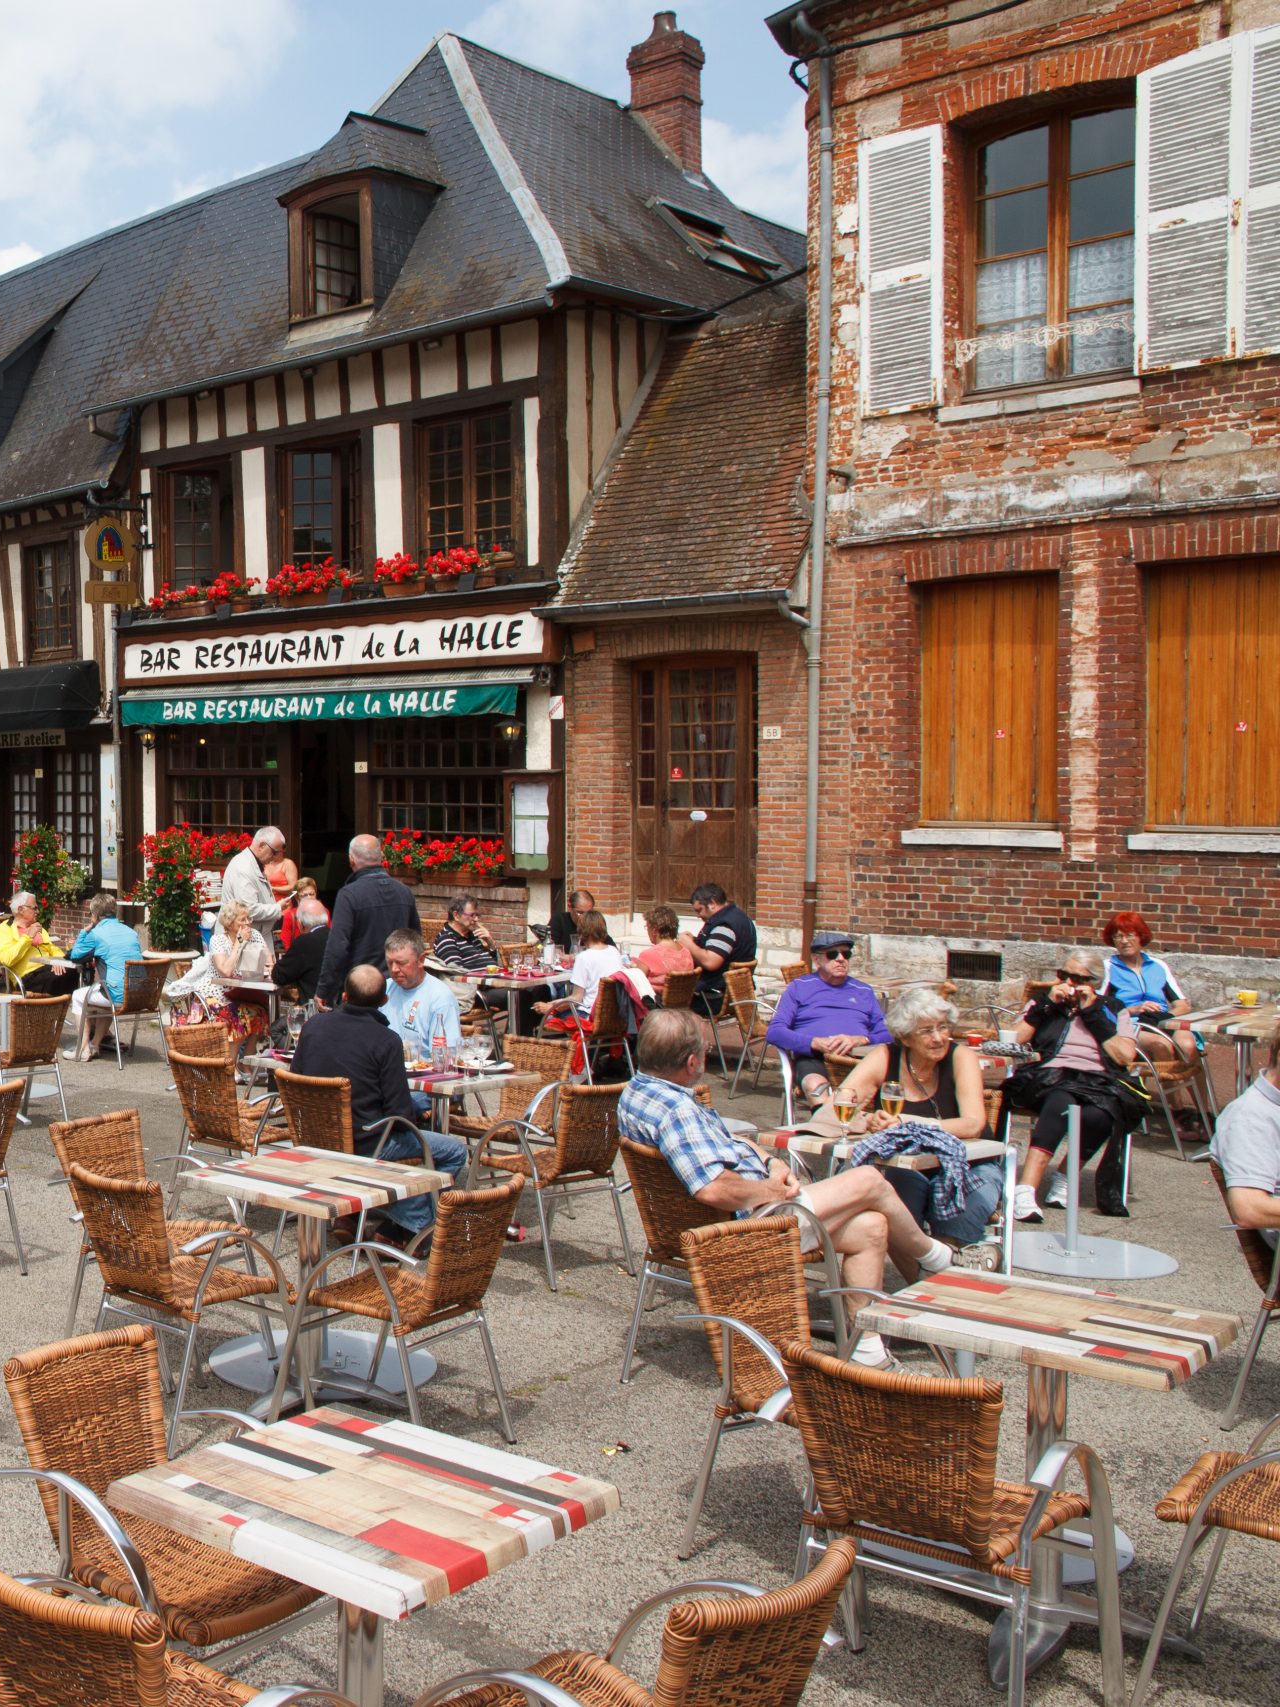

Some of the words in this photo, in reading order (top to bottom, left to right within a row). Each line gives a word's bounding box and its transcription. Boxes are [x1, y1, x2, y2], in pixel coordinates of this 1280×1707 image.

[140, 648, 181, 674] BAR
[195, 635, 345, 669] RESTAURANT
[361, 632, 385, 660] de
[439, 620, 524, 653] HALLE
[162, 701, 197, 720] BAR
[203, 696, 326, 719] RESTAURANT
[334, 695, 354, 716] de
[364, 693, 381, 715] la
[389, 689, 458, 716] HALLE
[23, 731, 62, 746] atelier
[766, 728, 778, 737] 5B
